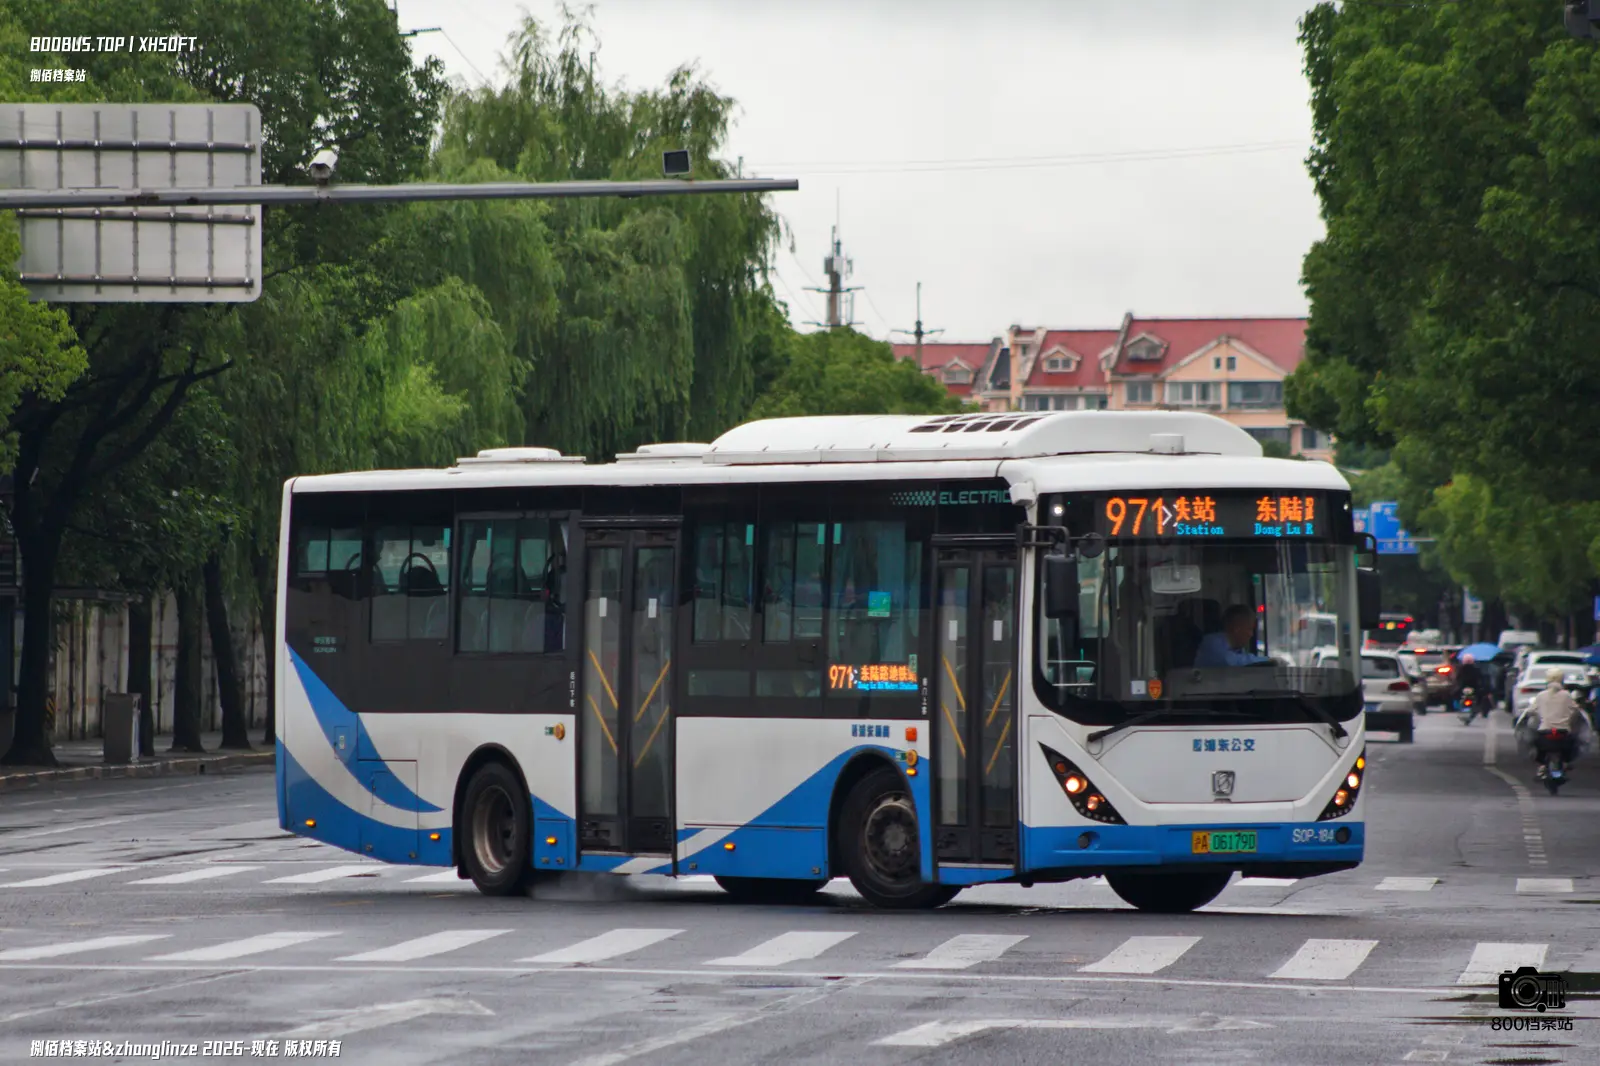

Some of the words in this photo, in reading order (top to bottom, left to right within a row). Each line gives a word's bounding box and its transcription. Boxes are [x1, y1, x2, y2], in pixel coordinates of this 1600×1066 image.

[1106, 497, 1164, 536] 971
[1177, 523, 1224, 535] Station
[1254, 523, 1282, 537] Dong
[1286, 523, 1300, 535] Lu
[829, 665, 854, 689] 971
